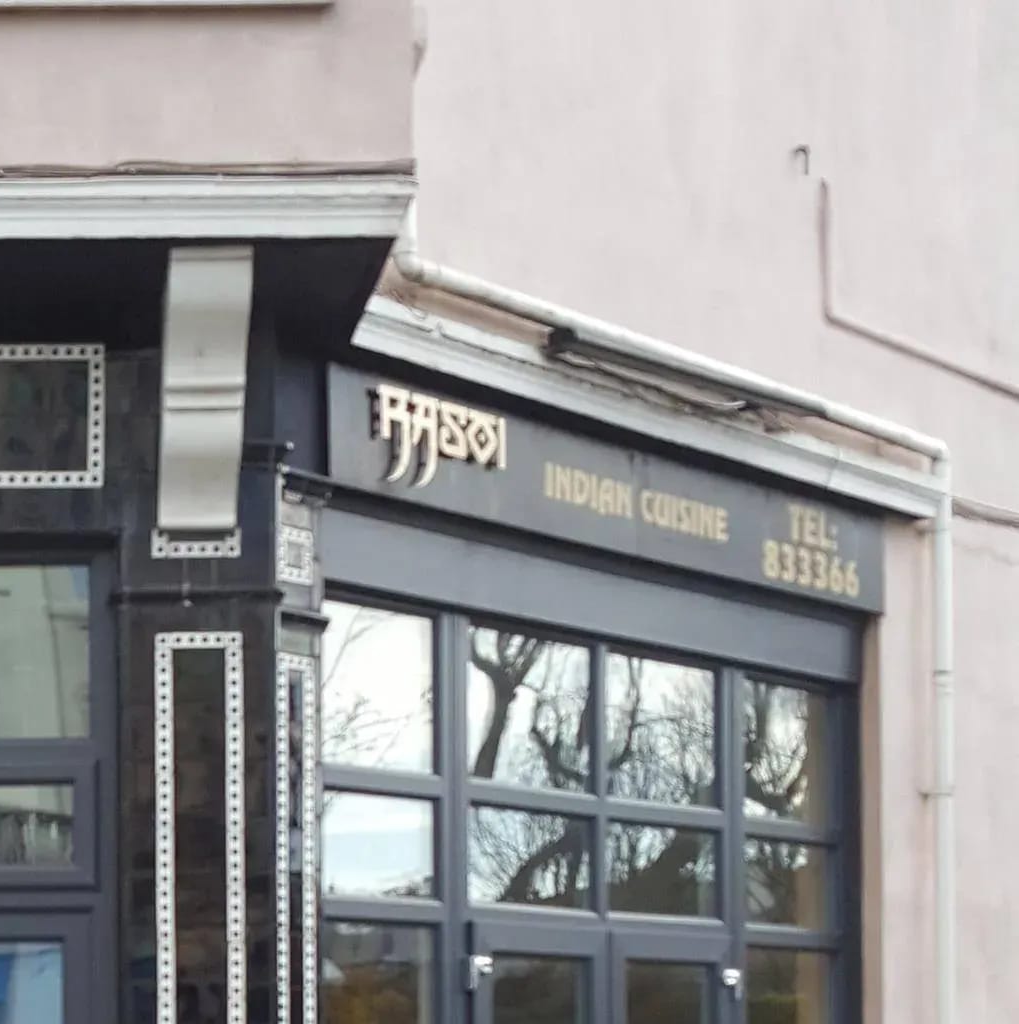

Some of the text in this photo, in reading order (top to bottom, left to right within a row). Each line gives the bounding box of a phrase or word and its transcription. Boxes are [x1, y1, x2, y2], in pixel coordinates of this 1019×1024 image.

[544, 462, 730, 541] INDIAN CUISINE
[788, 504, 838, 550] TEL:
[762, 540, 860, 597] 833366
